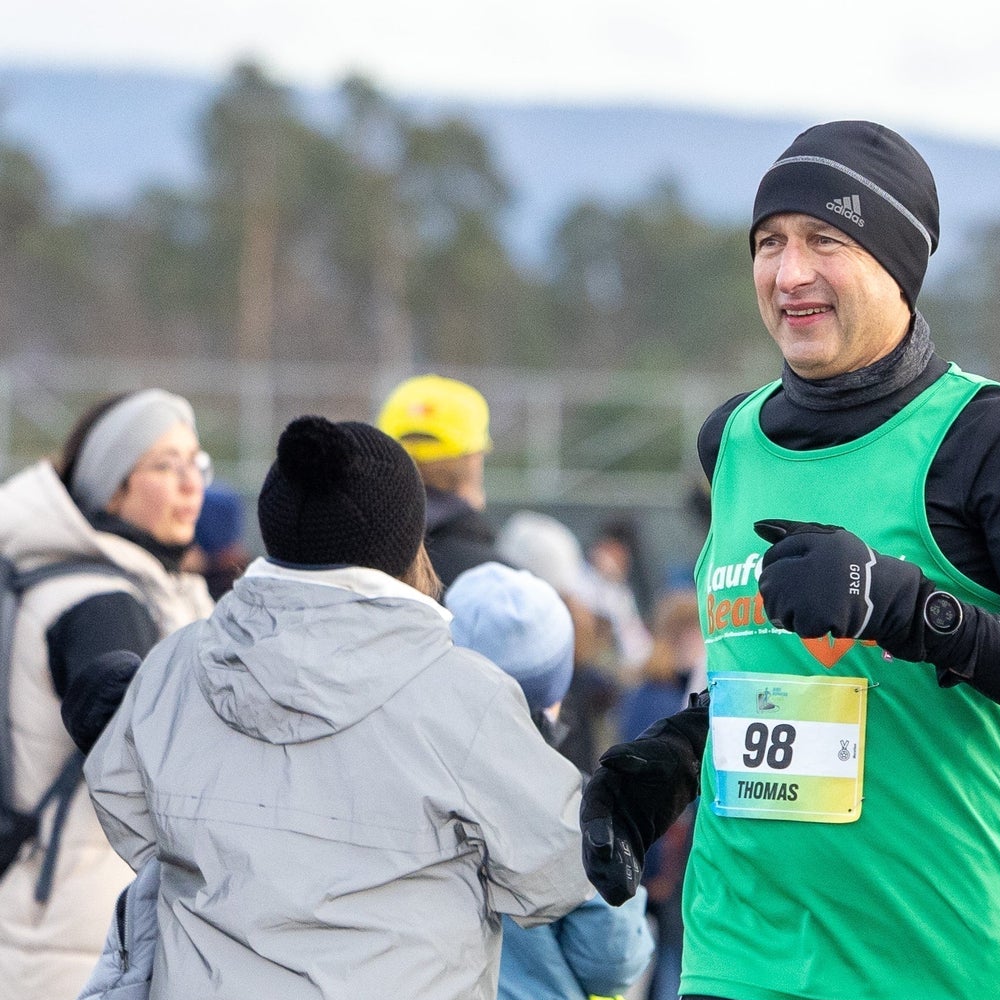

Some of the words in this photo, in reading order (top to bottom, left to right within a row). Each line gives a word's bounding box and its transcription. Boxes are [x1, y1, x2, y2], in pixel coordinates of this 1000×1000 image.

[825, 201, 865, 228] adidas
[849, 563, 861, 596] GORE
[708, 591, 767, 635] Beat
[742, 721, 797, 770] 98
[737, 780, 799, 802] THOMAS
